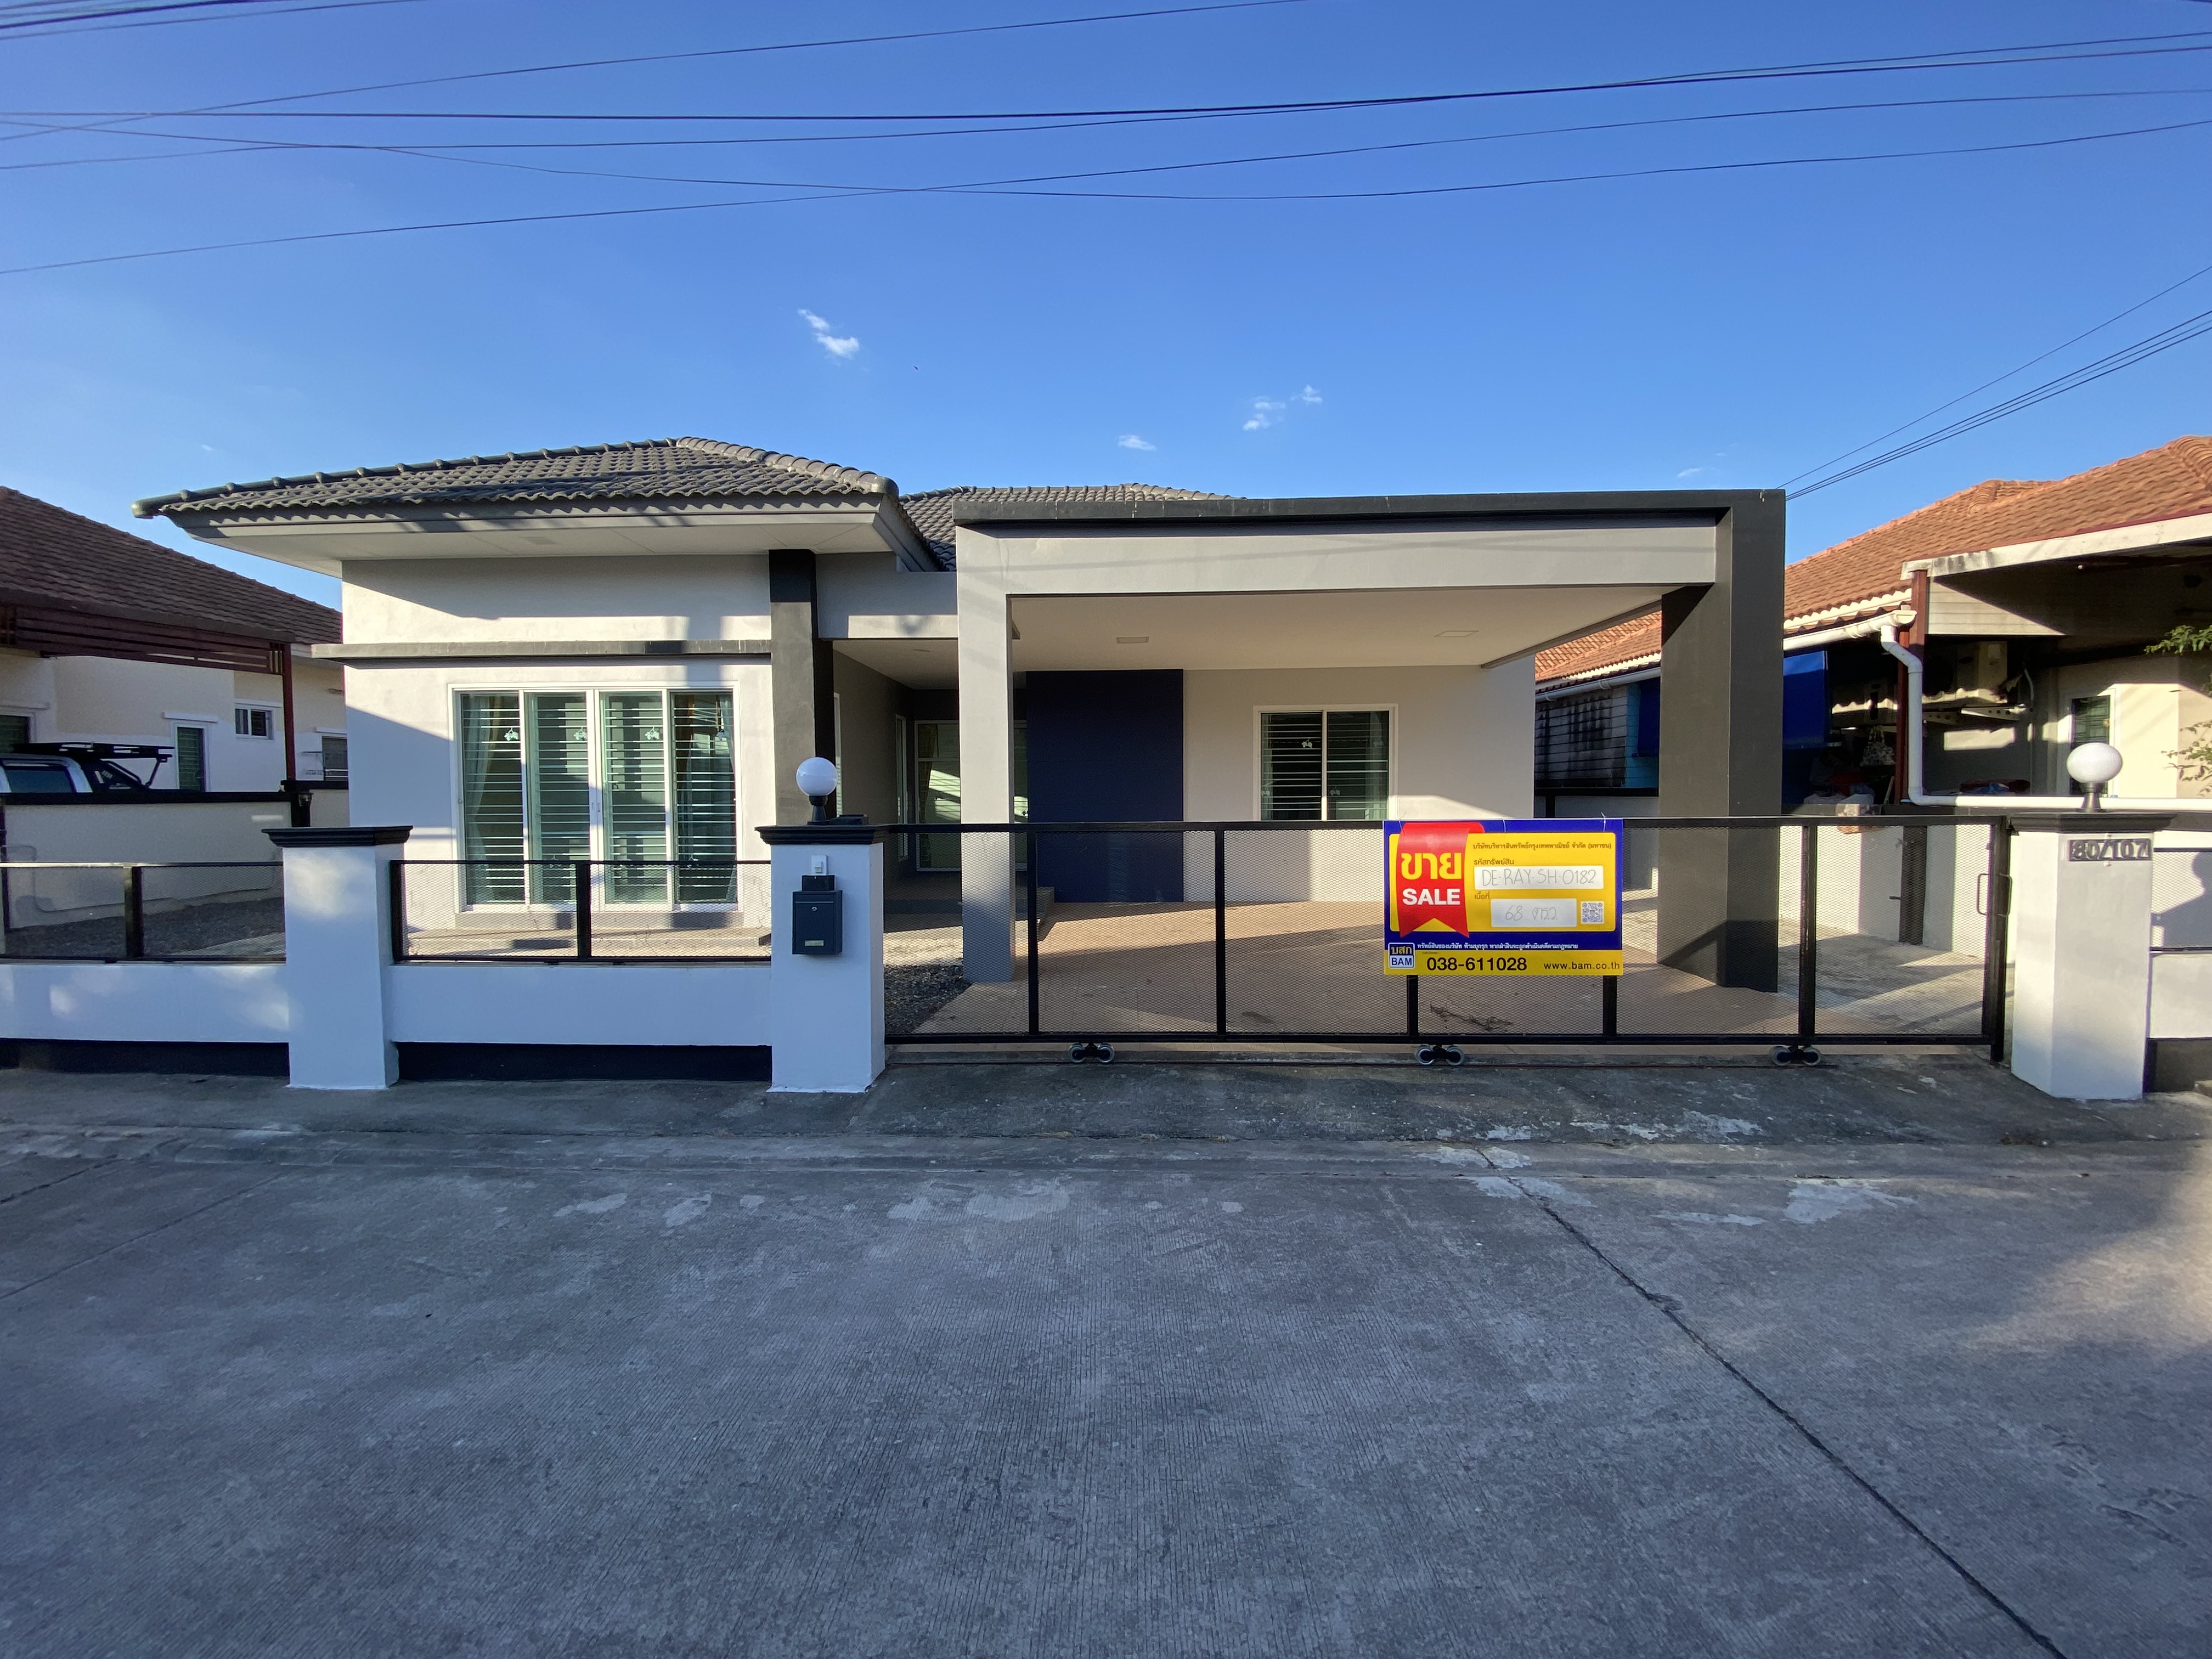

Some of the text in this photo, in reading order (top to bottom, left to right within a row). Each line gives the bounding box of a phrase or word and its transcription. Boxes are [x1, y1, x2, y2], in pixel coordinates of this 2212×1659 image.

[2072, 840, 2148, 860] 80/107
[1401, 853, 1462, 879] ขาย
[1402, 888, 1460, 905] SALE
[1474, 891, 1491, 900] เนื้อที่
[1505, 905, 1523, 921] 68
[1391, 946, 1412, 955] บสก
[1391, 957, 1413, 966] BAM
[1426, 957, 1527, 971] 038-611028
[1543, 961, 1620, 970] www.bam.co.th
